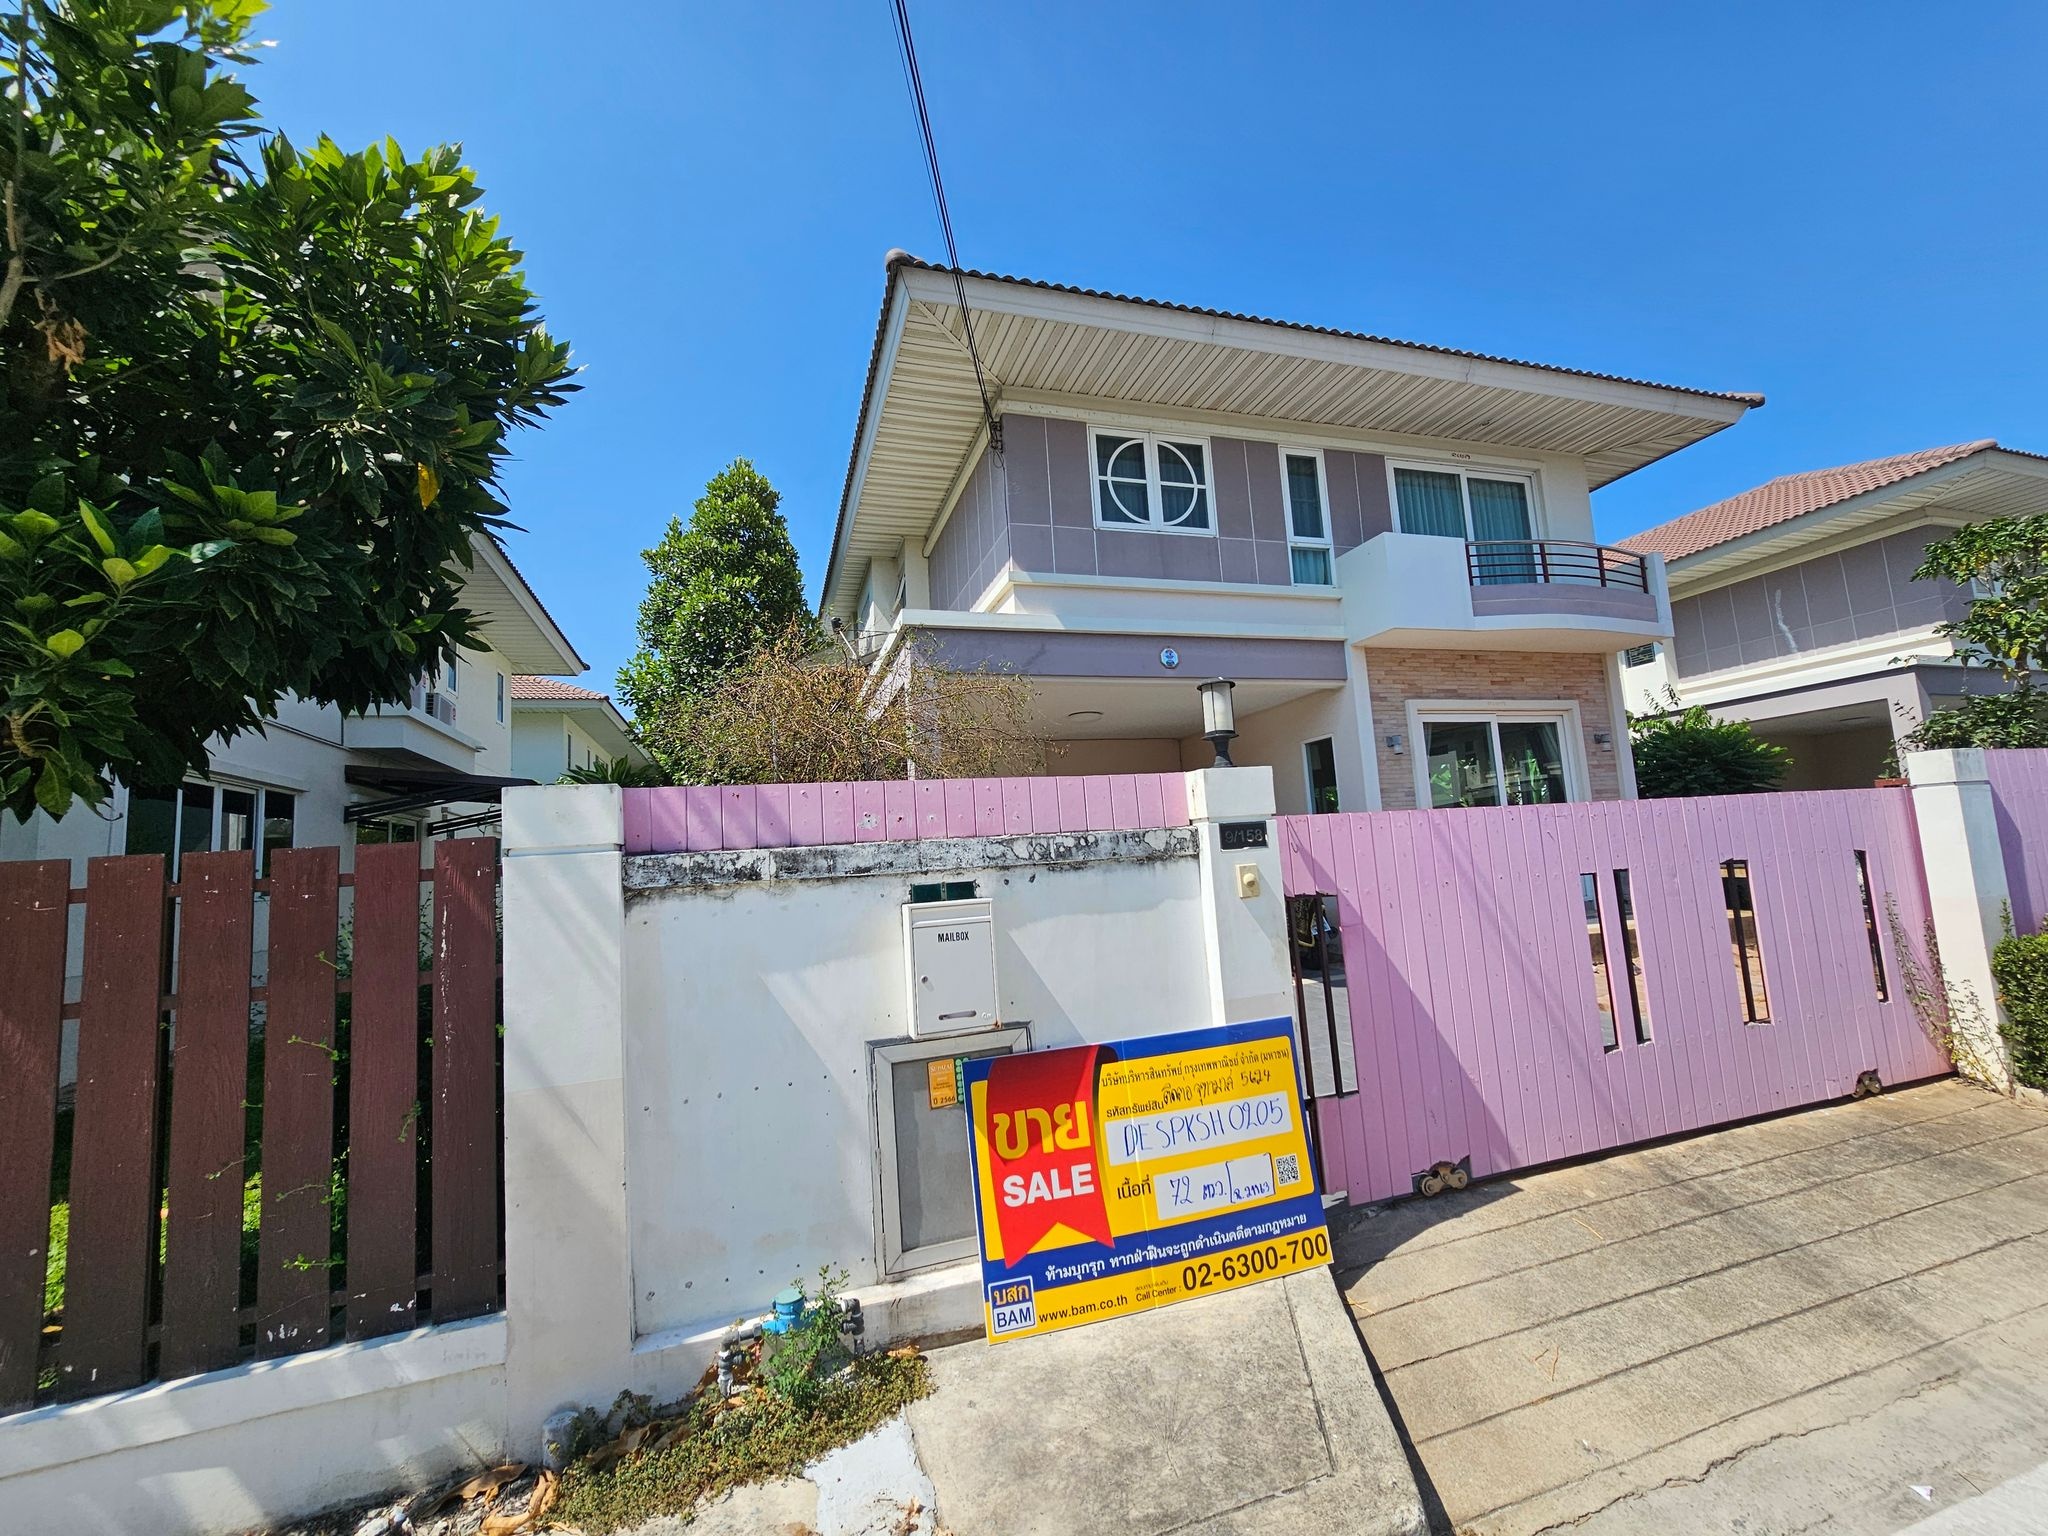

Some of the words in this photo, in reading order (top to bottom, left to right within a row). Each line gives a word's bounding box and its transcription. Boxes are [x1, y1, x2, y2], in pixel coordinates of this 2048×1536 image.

[1225, 829, 1263, 844] 9/158
[937, 931, 970, 943] MAILBOX
[993, 1101, 1091, 1160] ขาย
[1003, 1163, 1095, 1208] SALE
[1117, 1174, 1152, 1200] เนื้อที่
[1169, 1175, 1193, 1206] 72
[1045, 1260, 1105, 1282] ห้ามบุกรุก
[1135, 1290, 1151, 1302] Call
[1182, 1233, 1328, 1291] 02-6300-700
[993, 1284, 1030, 1307] บสก
[1039, 1294, 1128, 1323] www.bam.co.th
[996, 1306, 1031, 1328] BAM
